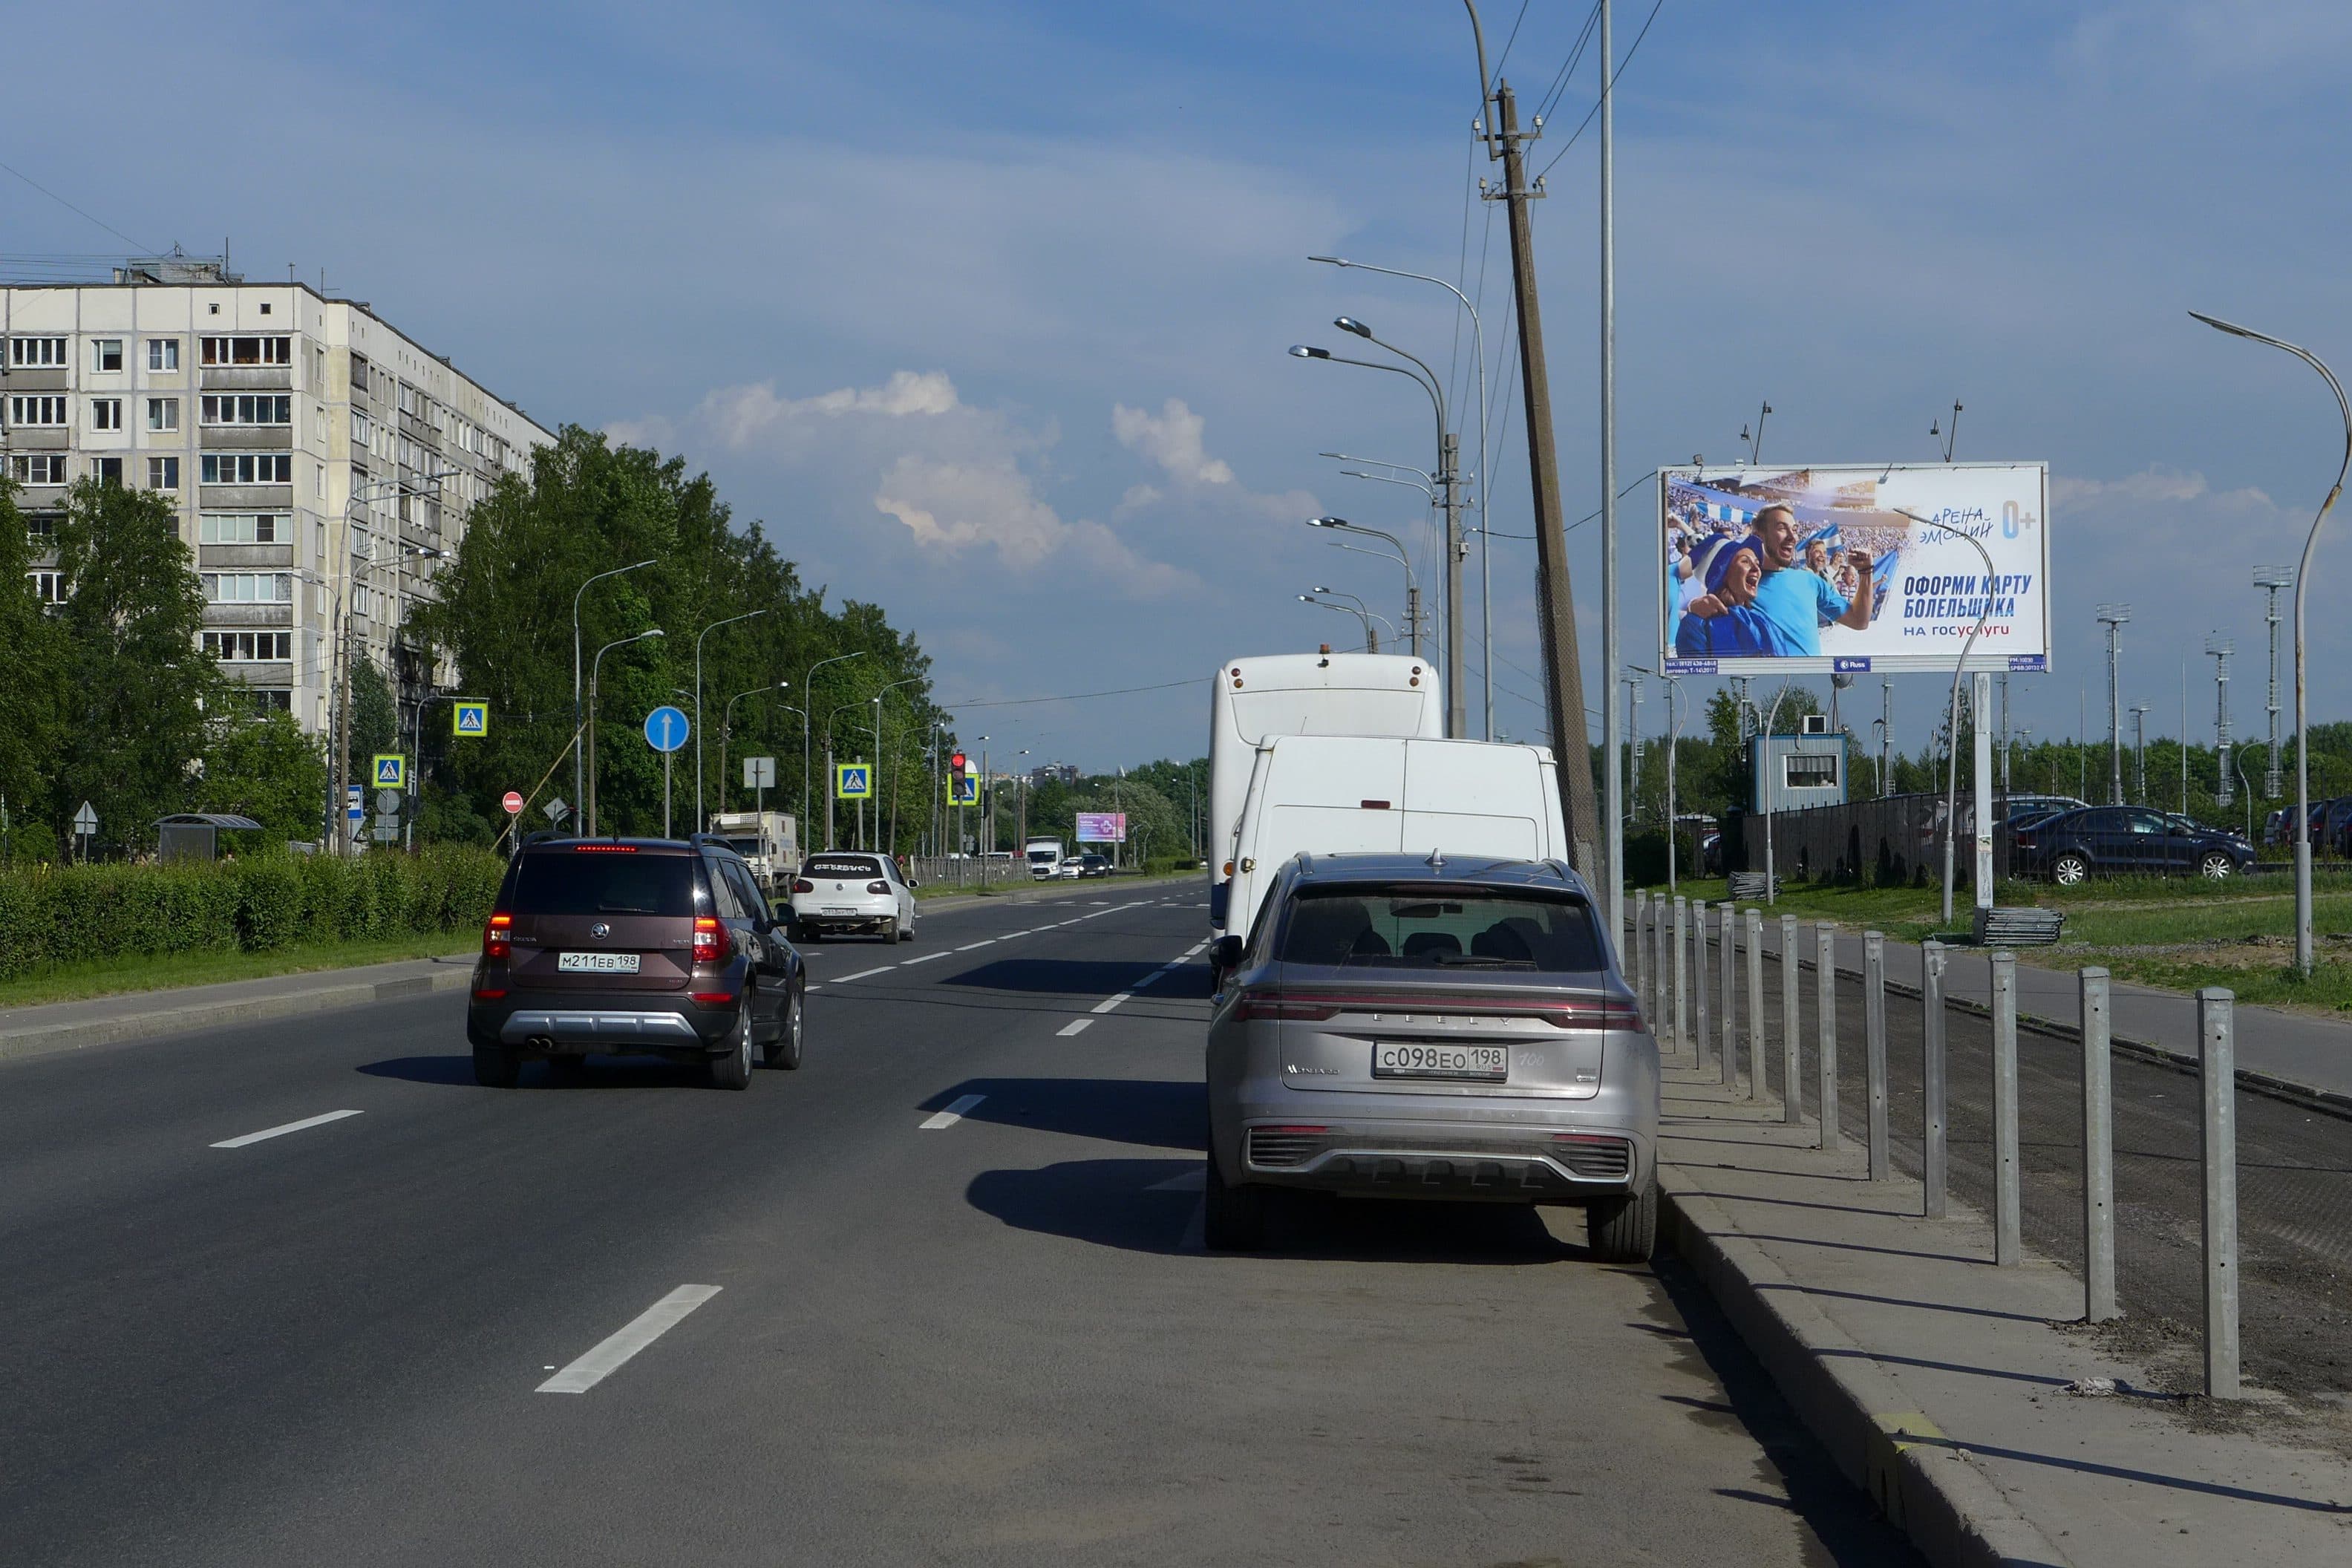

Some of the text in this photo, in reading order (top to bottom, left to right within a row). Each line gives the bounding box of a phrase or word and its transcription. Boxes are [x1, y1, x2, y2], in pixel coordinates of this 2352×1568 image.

[1932, 507, 1983, 526] АРЕНА
[2003, 500, 2036, 539] 0+
[1904, 575, 2032, 595] ОФОРМИ КАРТУ
[1904, 627, 1926, 636] НА
[618, 956, 636, 965] 198
[1383, 1047, 1501, 1068] С098ЕО 198
